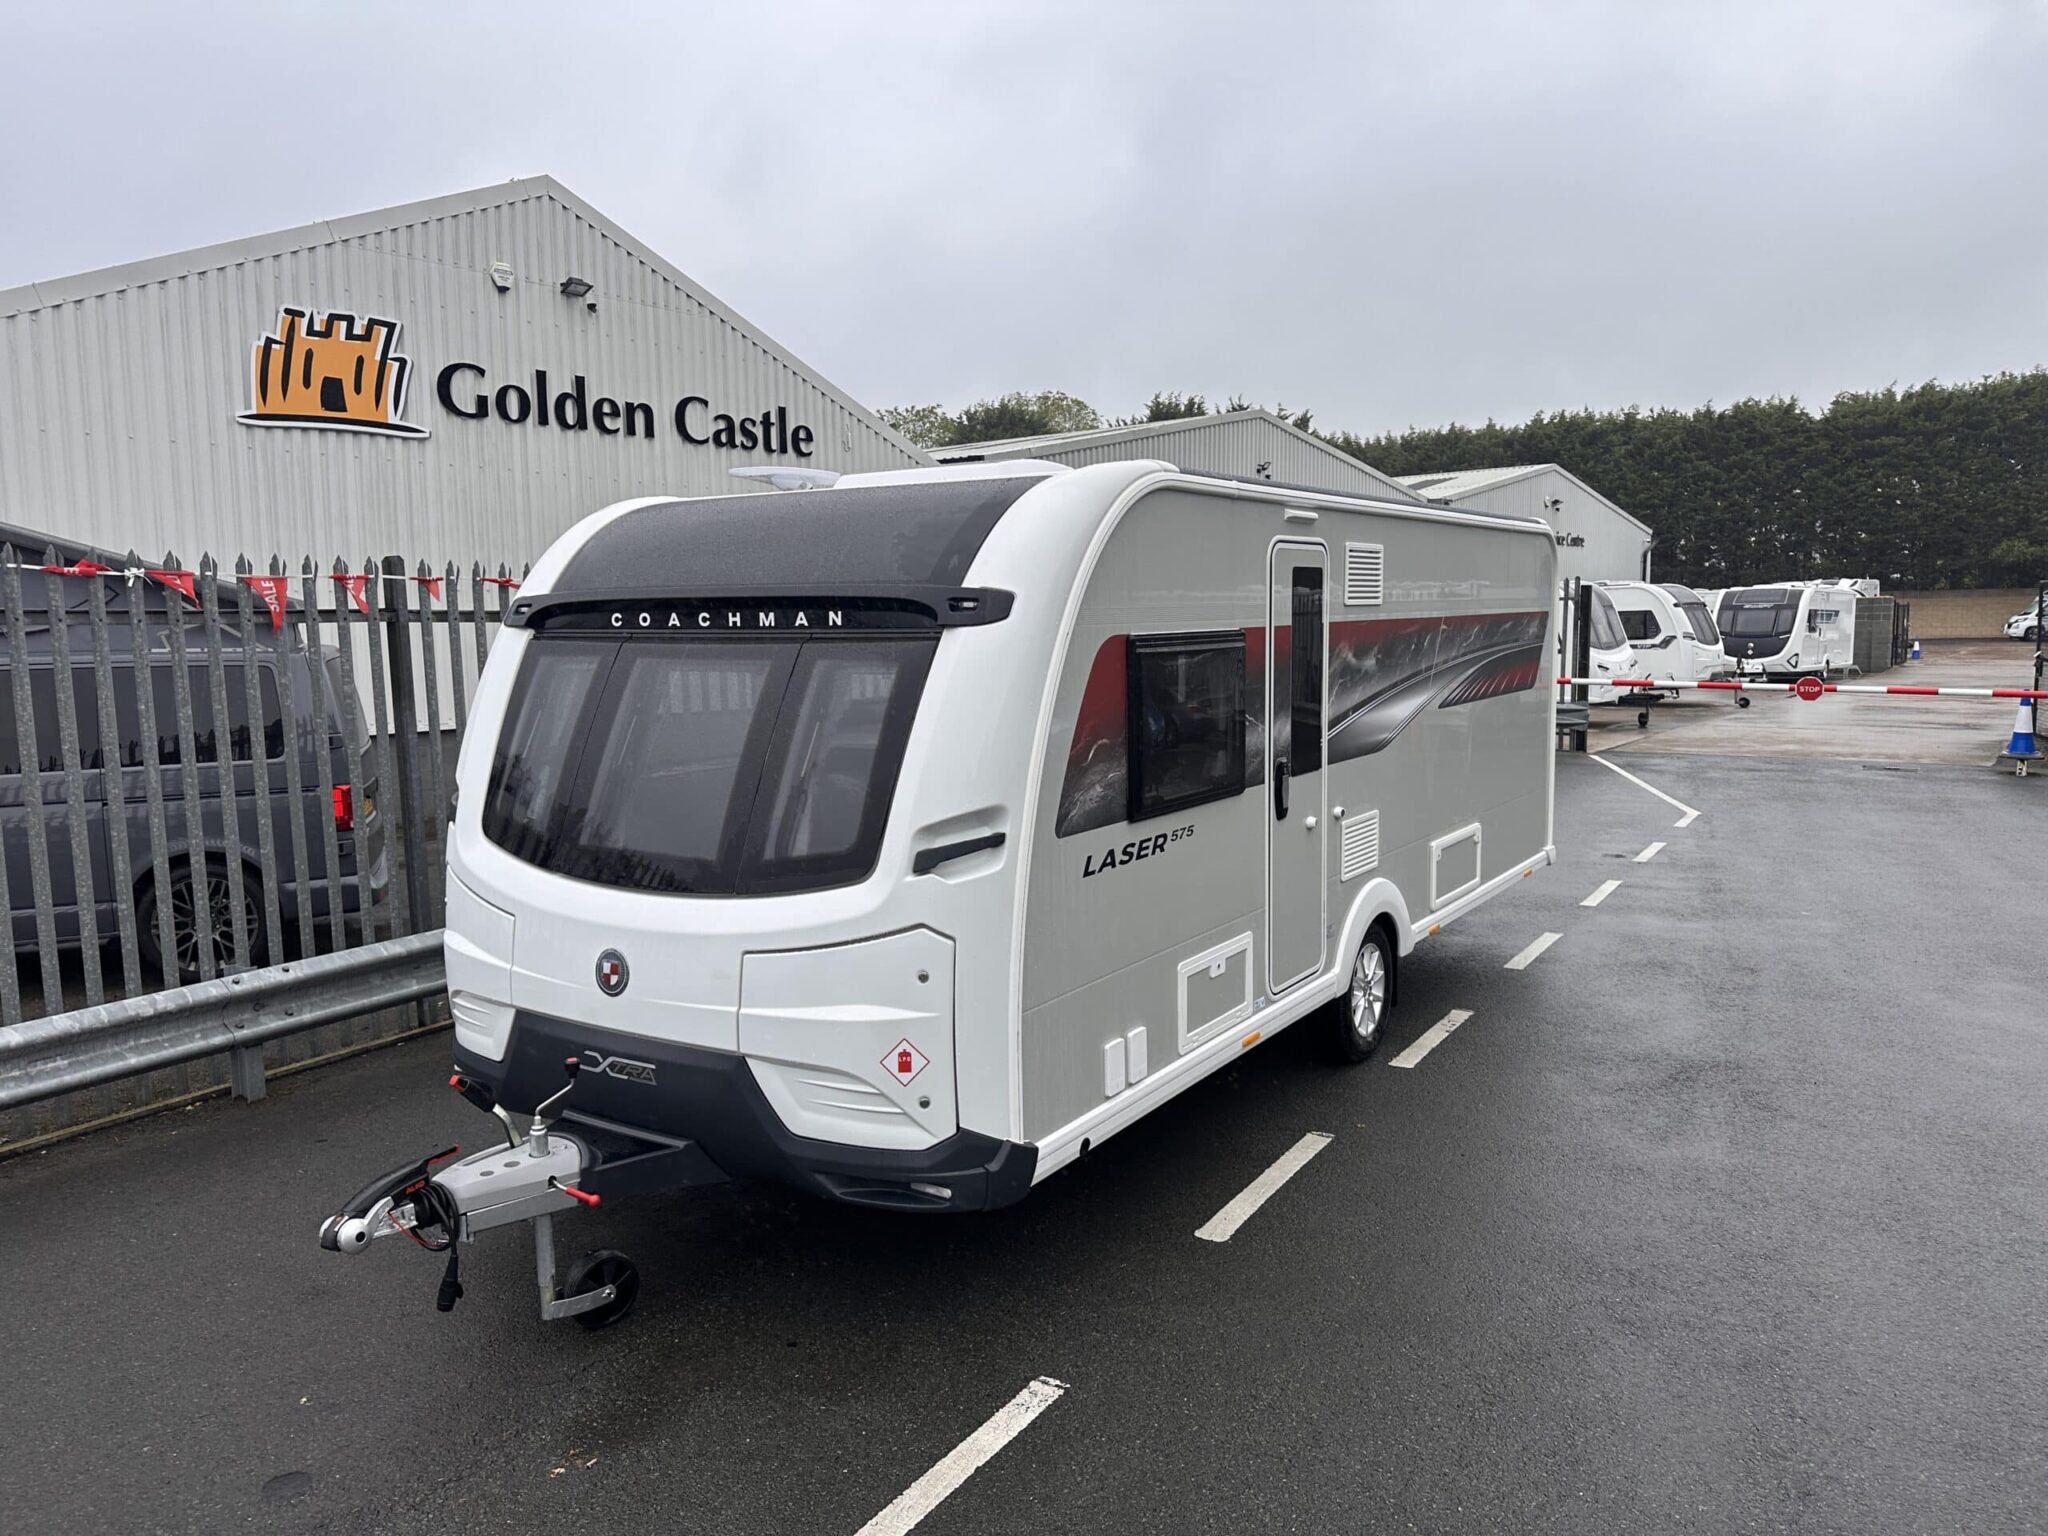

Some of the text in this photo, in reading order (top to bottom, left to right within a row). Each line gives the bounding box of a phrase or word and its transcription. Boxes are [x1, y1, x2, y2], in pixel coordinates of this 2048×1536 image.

[436, 362, 814, 457] Golden Castle
[1566, 533, 1584, 547] Centre
[258, 580, 280, 613] SALE
[611, 611, 843, 627] COACHMAN
[1082, 824, 1195, 878] LASER 575
